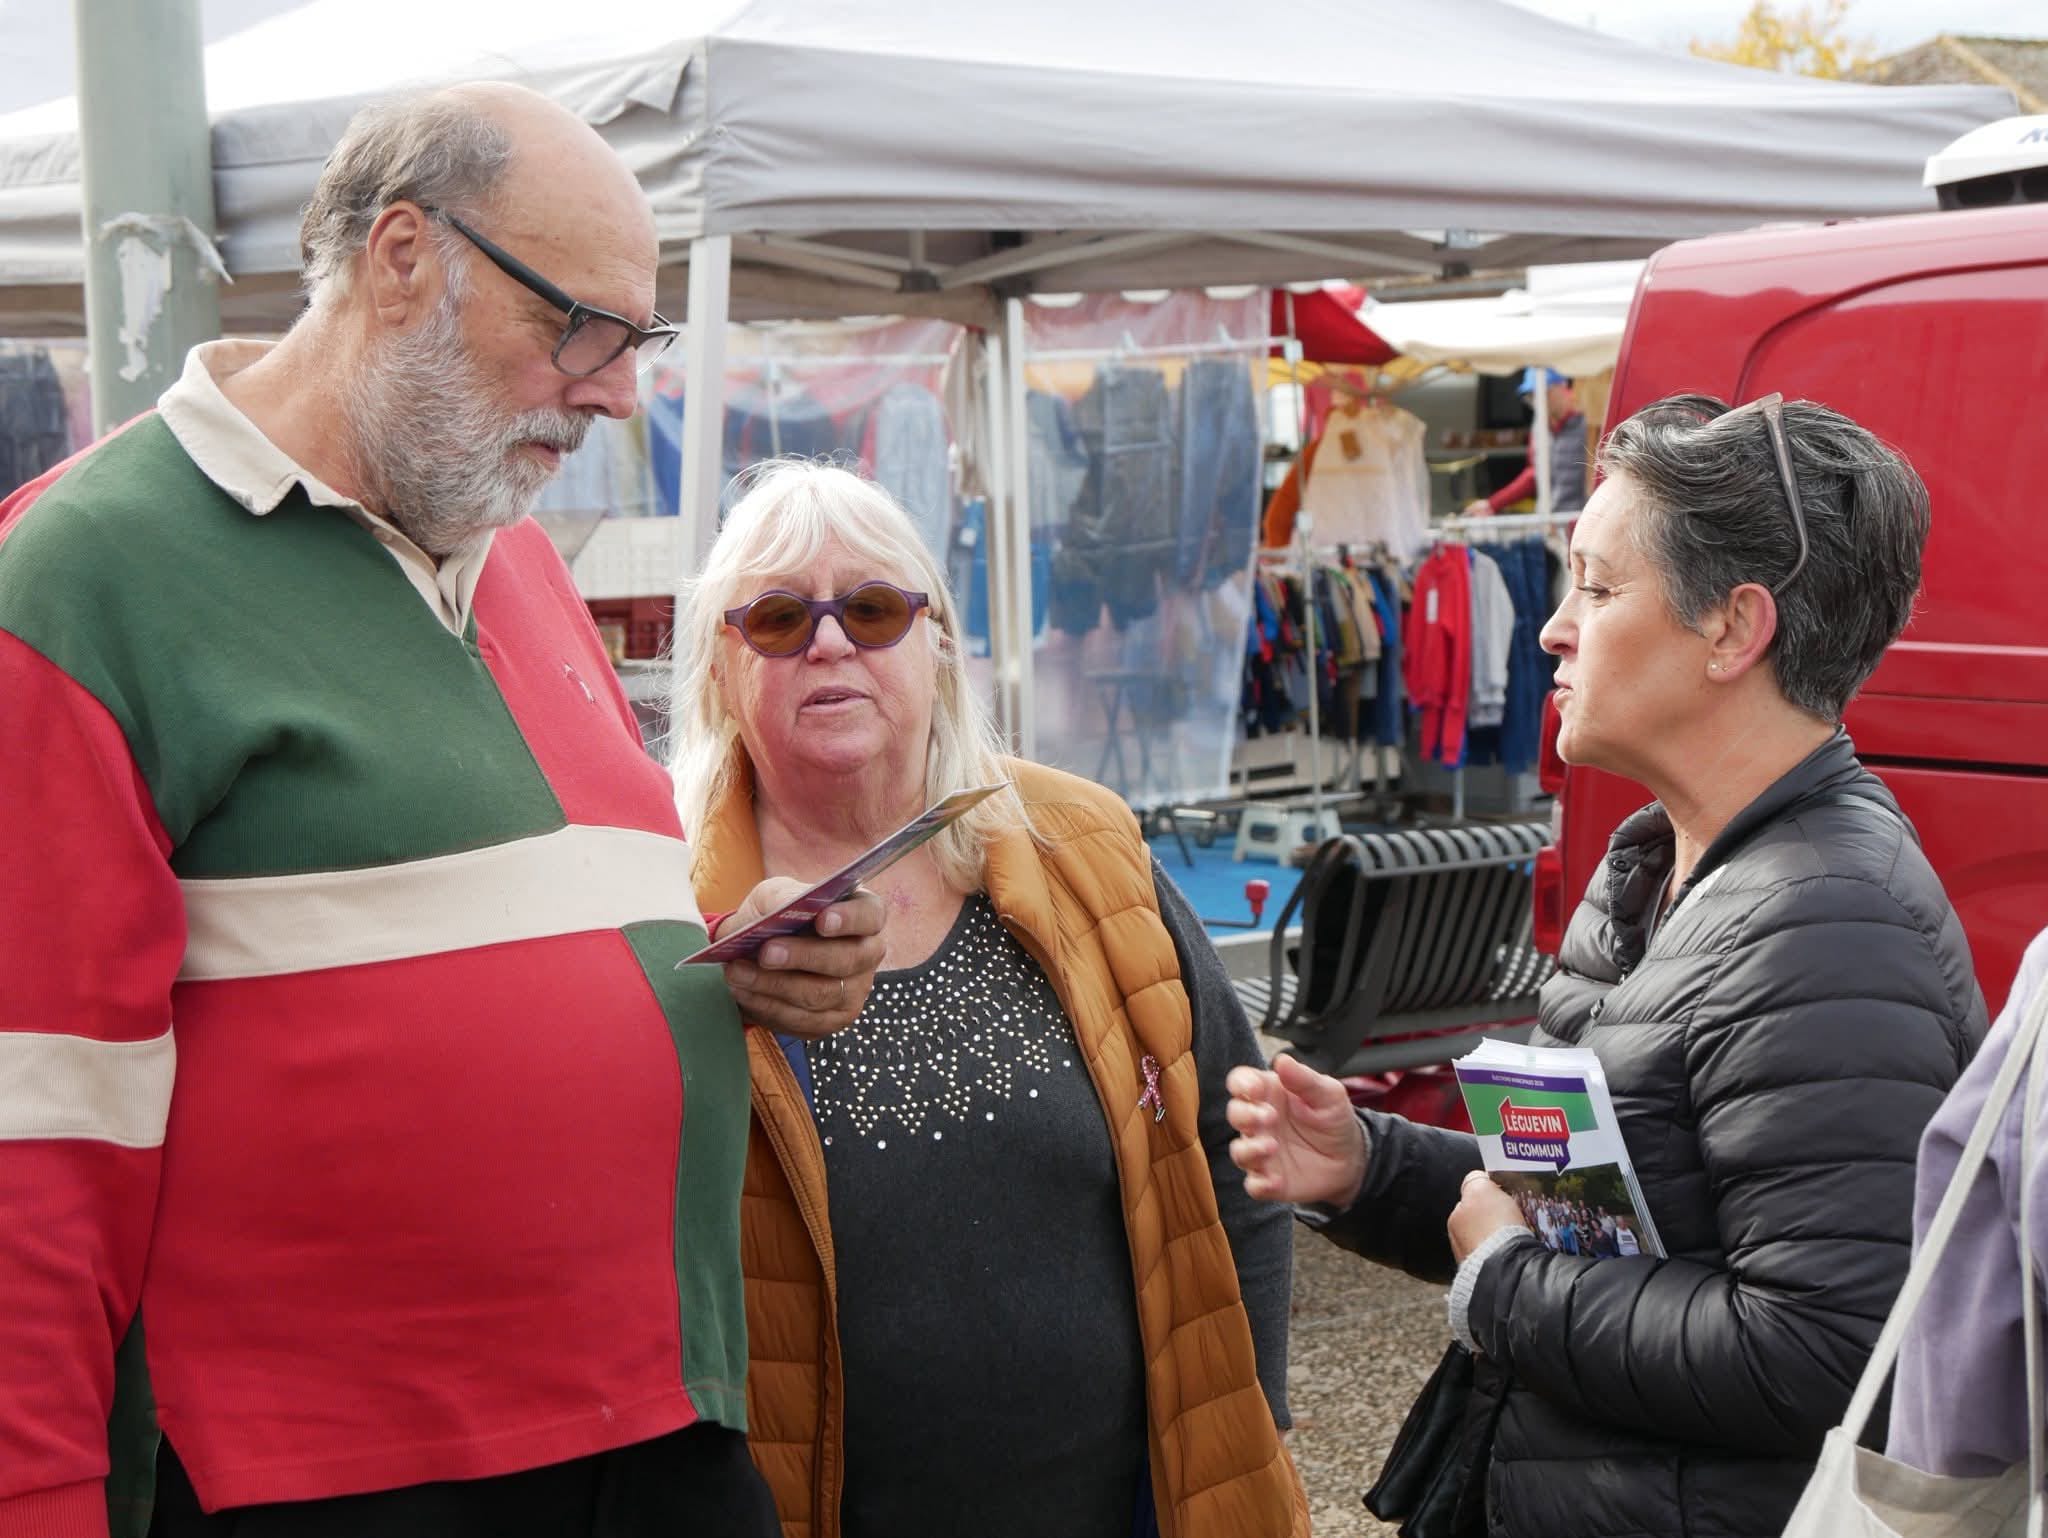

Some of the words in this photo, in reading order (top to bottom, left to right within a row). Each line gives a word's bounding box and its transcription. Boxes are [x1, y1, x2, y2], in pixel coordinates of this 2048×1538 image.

[1505, 1110, 1562, 1133] LÉGUEVIN
[1506, 1142, 1519, 1156] EN
[1519, 1142, 1564, 1158] COMMUN
